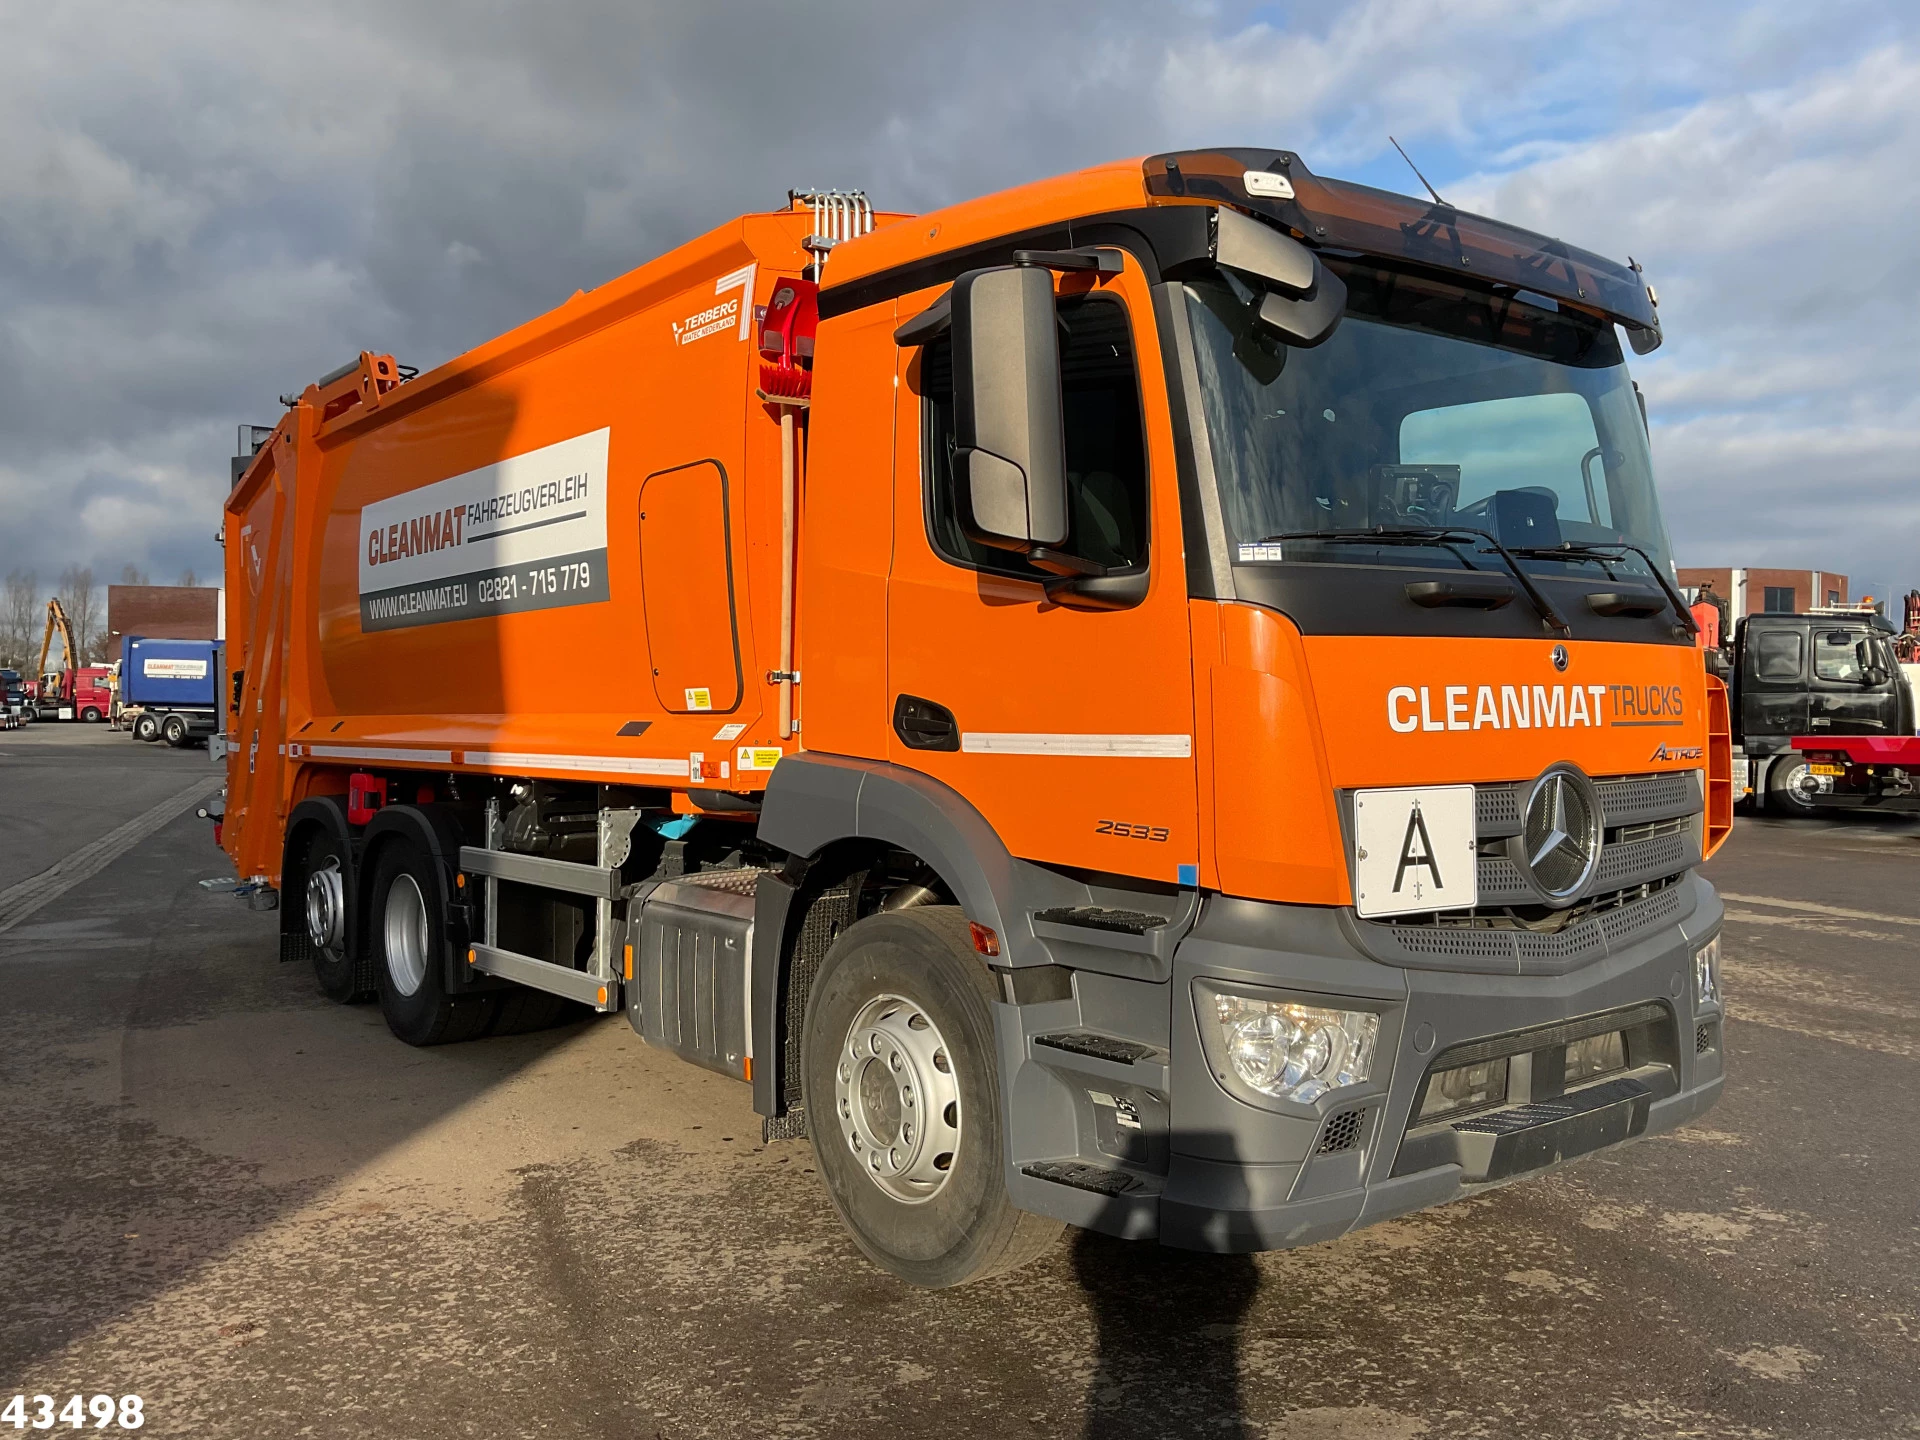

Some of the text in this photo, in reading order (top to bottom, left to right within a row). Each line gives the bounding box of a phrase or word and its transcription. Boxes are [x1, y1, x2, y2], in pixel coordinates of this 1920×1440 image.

[683, 317, 735, 343] MATEC NEDERLAND
[684, 299, 738, 331] TERBERG
[368, 472, 588, 567] CLEANMAT FAHRZEUGVERLEIH
[369, 584, 468, 620] WWW.CLEANMAT.EU
[478, 575, 518, 604] 02821
[529, 568, 556, 596] 715
[561, 562, 590, 591] 779
[1387, 684, 1683, 733] CLEANMAT TRUCKS
[1095, 819, 1170, 842] 2533
[1392, 808, 1444, 893] A
